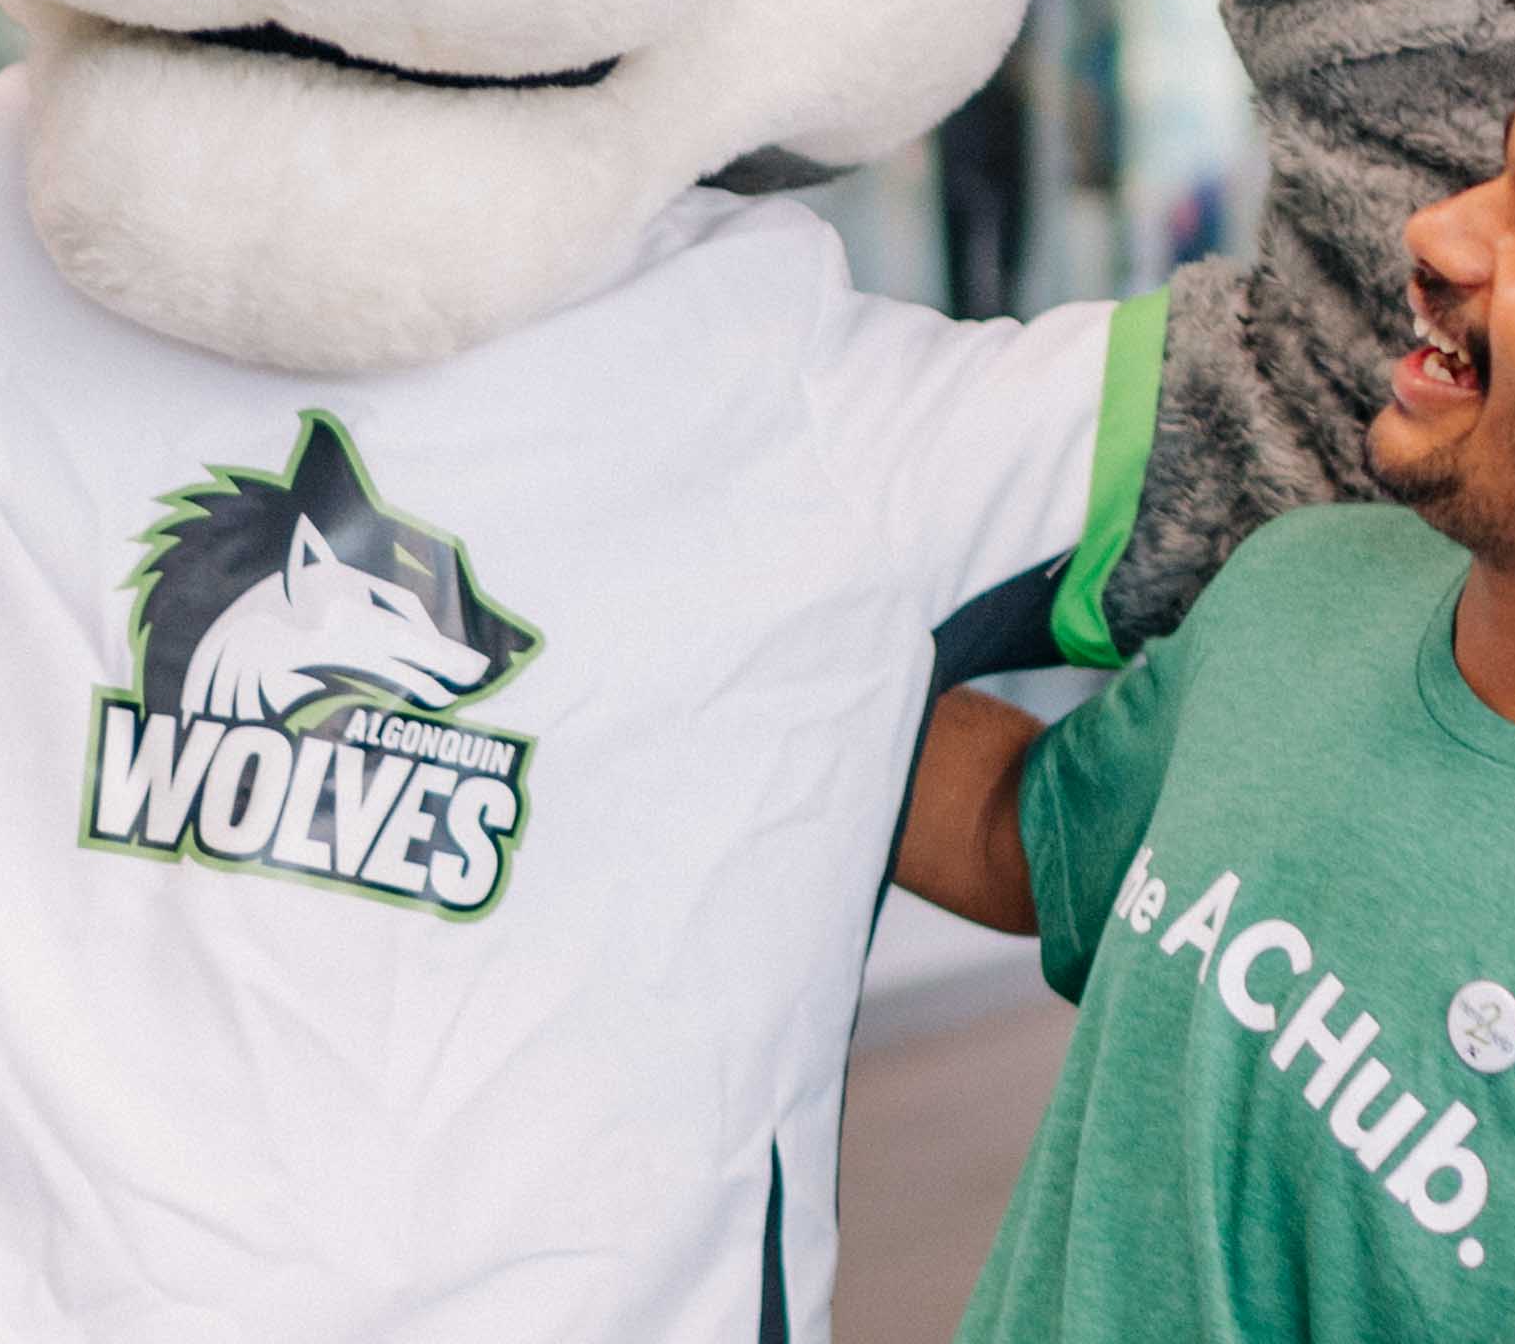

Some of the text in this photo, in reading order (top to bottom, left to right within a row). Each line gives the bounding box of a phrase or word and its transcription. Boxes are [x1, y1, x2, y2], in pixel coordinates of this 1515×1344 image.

[343, 708, 516, 777] ALGONQUIN
[96, 704, 517, 906] WOLVES
[1114, 846, 1167, 934] he
